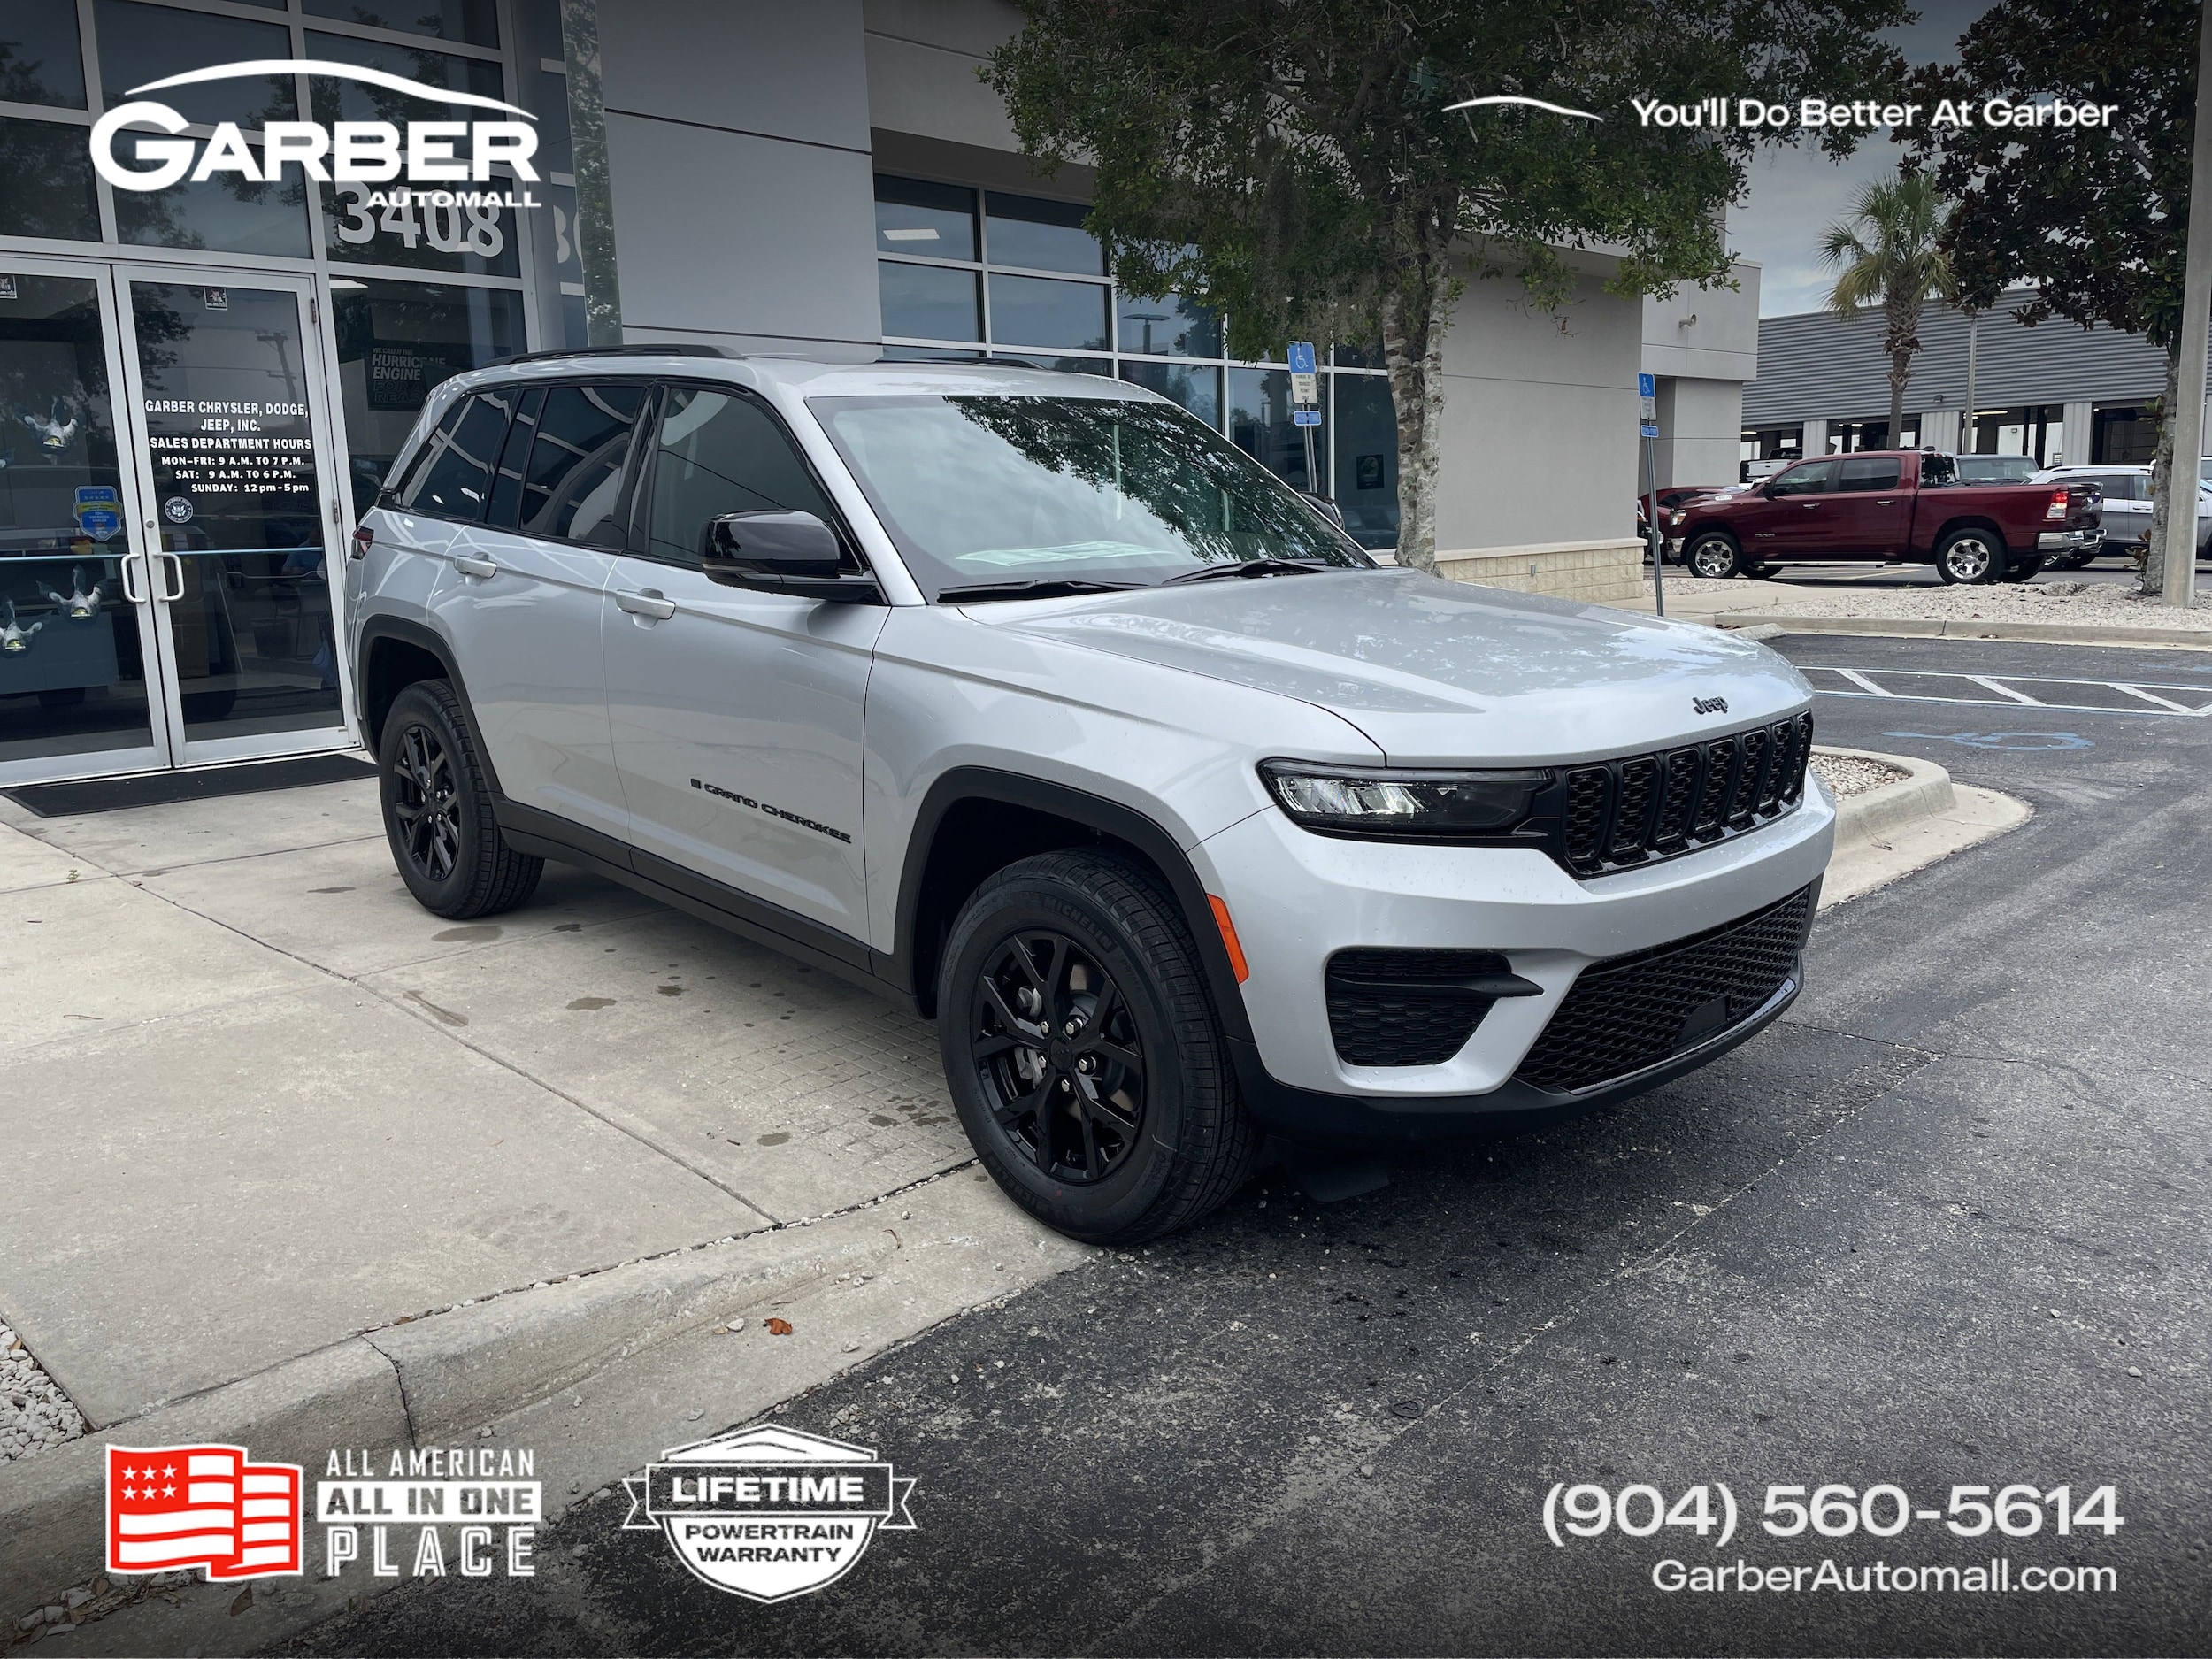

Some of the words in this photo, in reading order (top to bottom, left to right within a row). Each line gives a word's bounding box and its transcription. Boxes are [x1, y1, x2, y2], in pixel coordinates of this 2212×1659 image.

[336, 180, 504, 257] 3408
[373, 366, 421, 380] ENGINE
[374, 391, 424, 403] REAS
[145, 399, 195, 413] GARBER
[198, 401, 263, 418] CHRYSLER,
[265, 403, 309, 418] DODGE,
[200, 419, 234, 433] JEEP,
[238, 419, 261, 432] INC.
[150, 437, 189, 449] SALES
[191, 437, 269, 449] DEPARTMENT
[273, 438, 312, 449] HOURS
[219, 457, 226, 465] 9
[229, 457, 253, 465] A.M.
[256, 457, 269, 465] TO
[272, 457, 278, 465] 7
[281, 457, 305, 465] P.M.
[175, 470, 200, 479] SAT:
[208, 470, 215, 479] 9
[219, 470, 243, 479] A.M.
[246, 470, 259, 479] TO
[263, 470, 270, 479] 6
[272, 470, 296, 479] P.M.
[191, 483, 238, 492] SUNDAY:
[1692, 696, 1729, 715] Jeep
[703, 783, 758, 809] GRAND
[761, 803, 851, 844] CHEROKEE
[1043, 896, 1115, 952] MICHELIN
